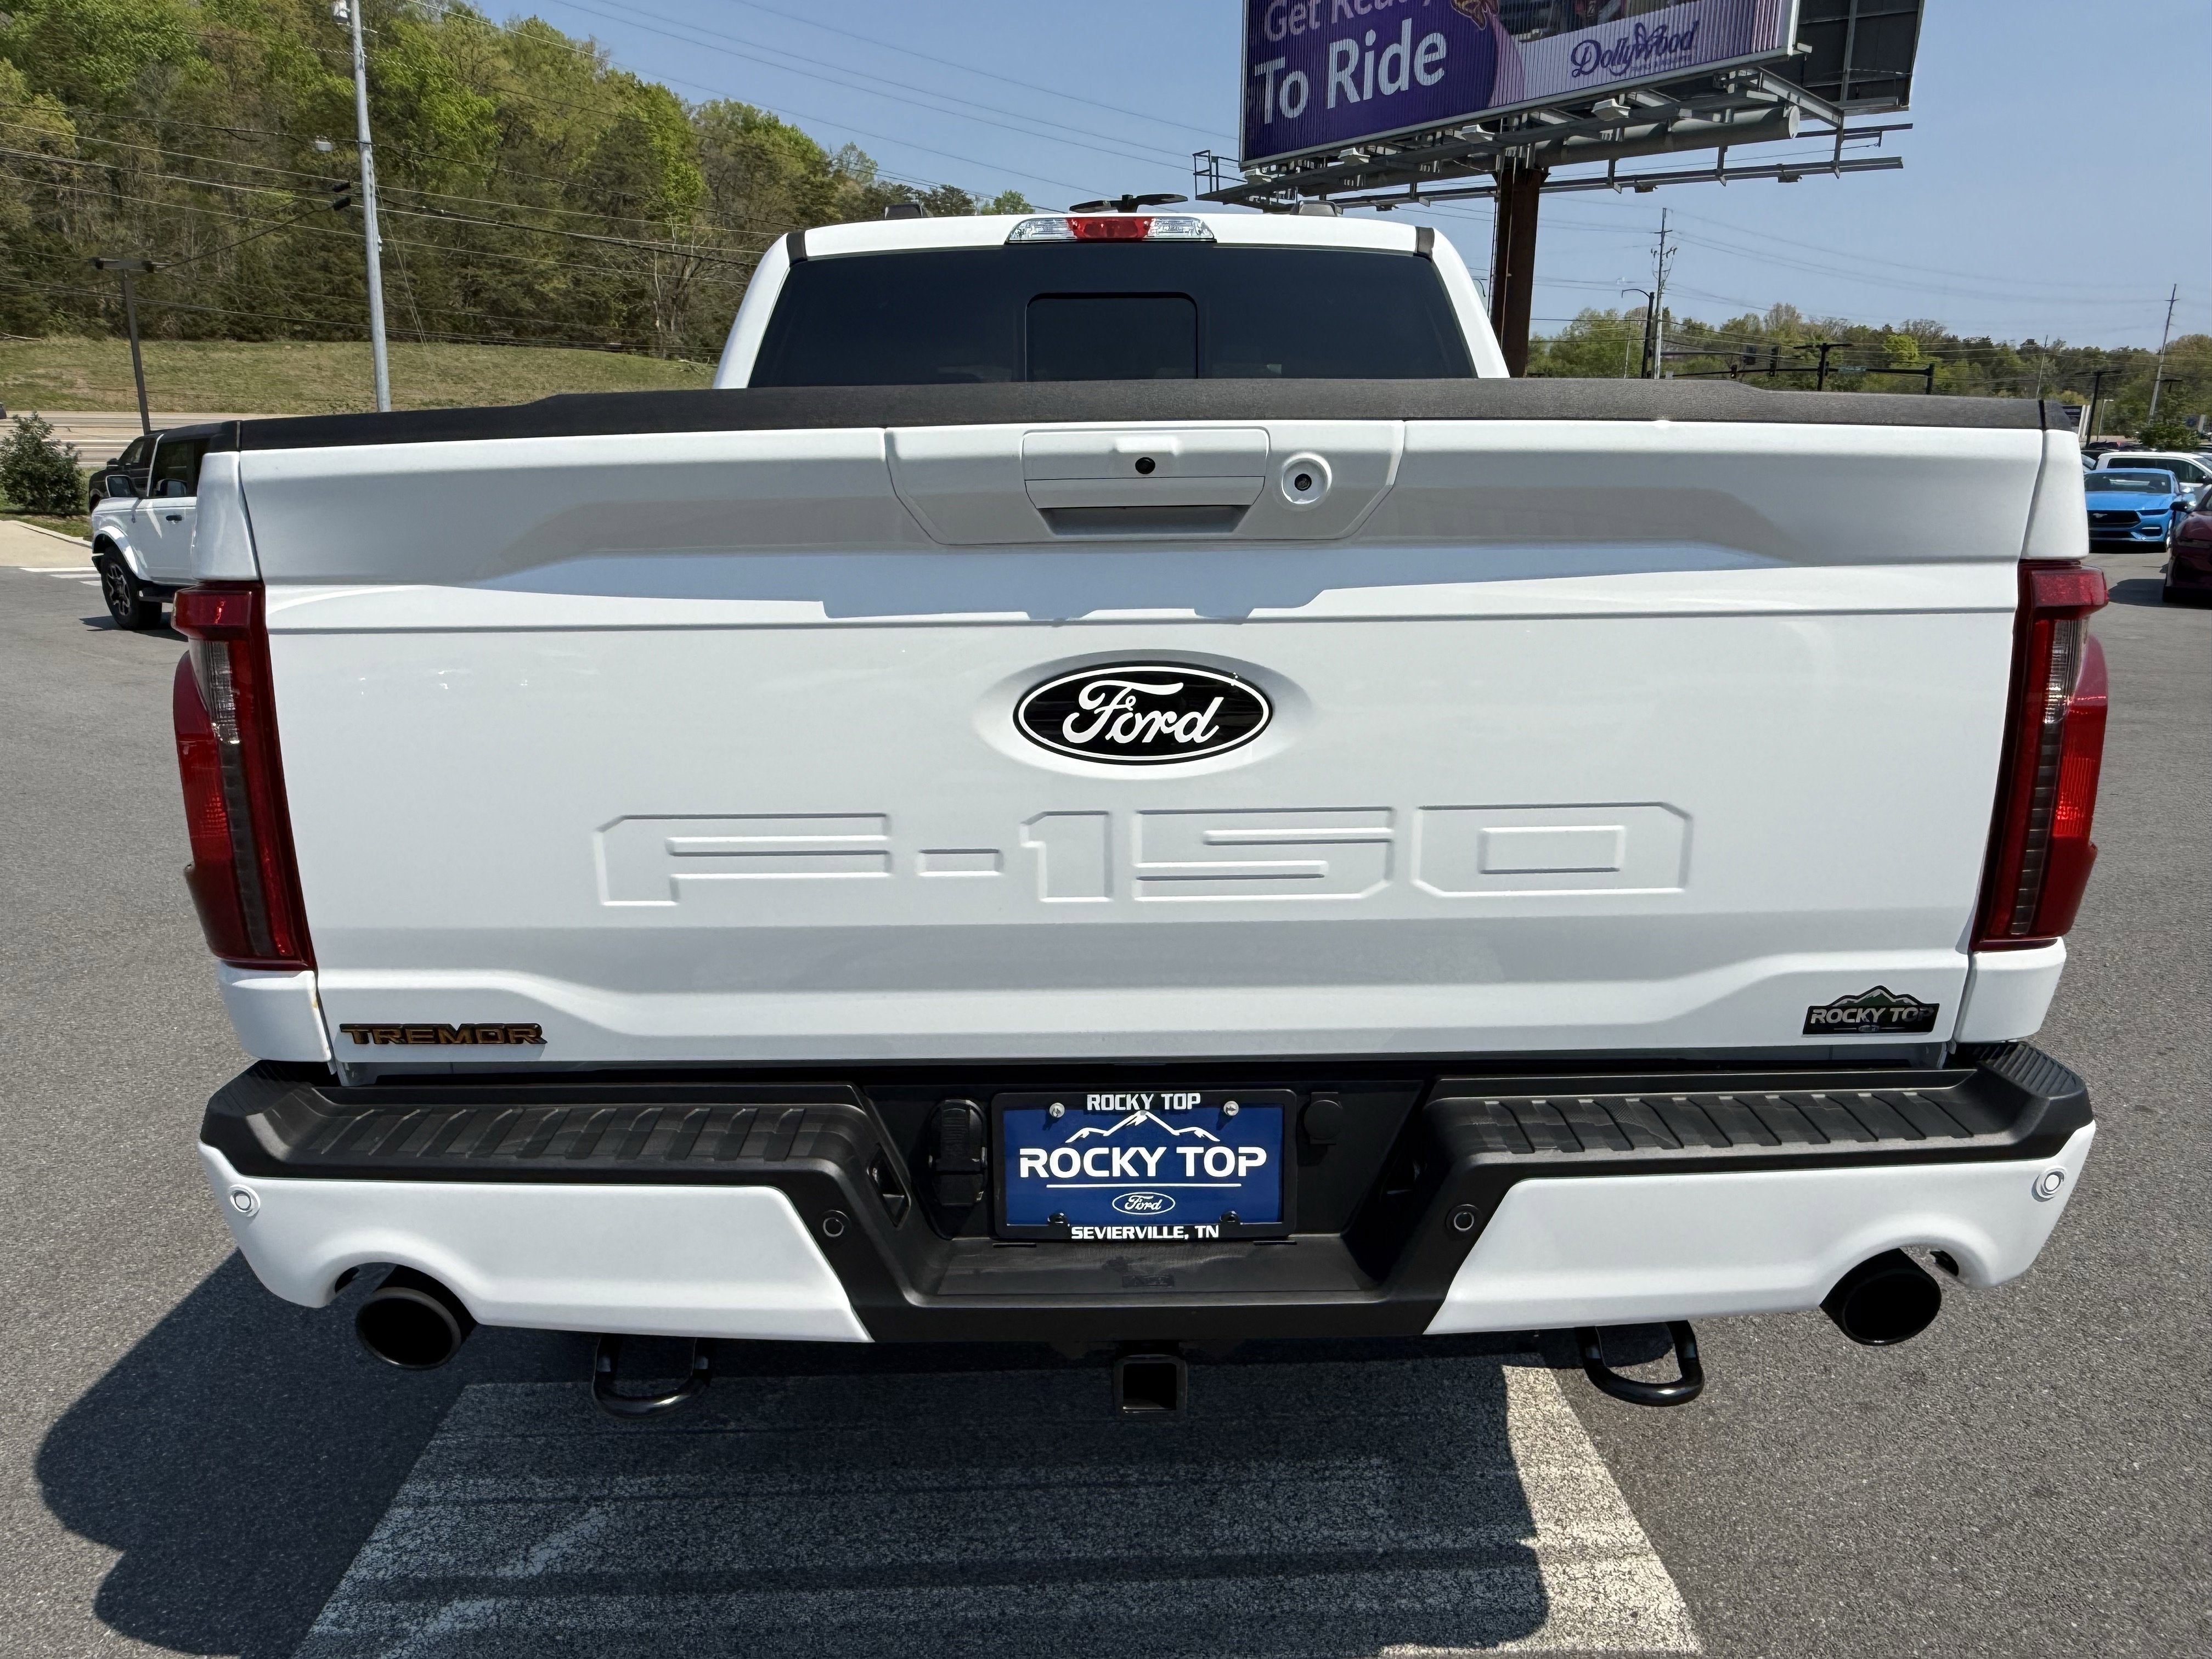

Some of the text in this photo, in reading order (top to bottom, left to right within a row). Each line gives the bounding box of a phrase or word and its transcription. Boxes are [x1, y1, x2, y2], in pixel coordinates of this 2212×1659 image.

[1264, 0, 1321, 41] Get
[1255, 18, 1446, 124] To Ride
[1062, 680, 1224, 743] Ford
[594, 803, 1692, 907] F-150
[1810, 1007, 1934, 1024] ROCKY TOP
[339, 1024, 548, 1045] TREMOR
[1087, 1093, 1201, 1111] ROCKY TOP
[1020, 1147, 1267, 1177] ROCKY TOP
[1124, 1195, 1162, 1211] Ford
[1071, 1225, 1219, 1240] SEVIERVILLE, TN
